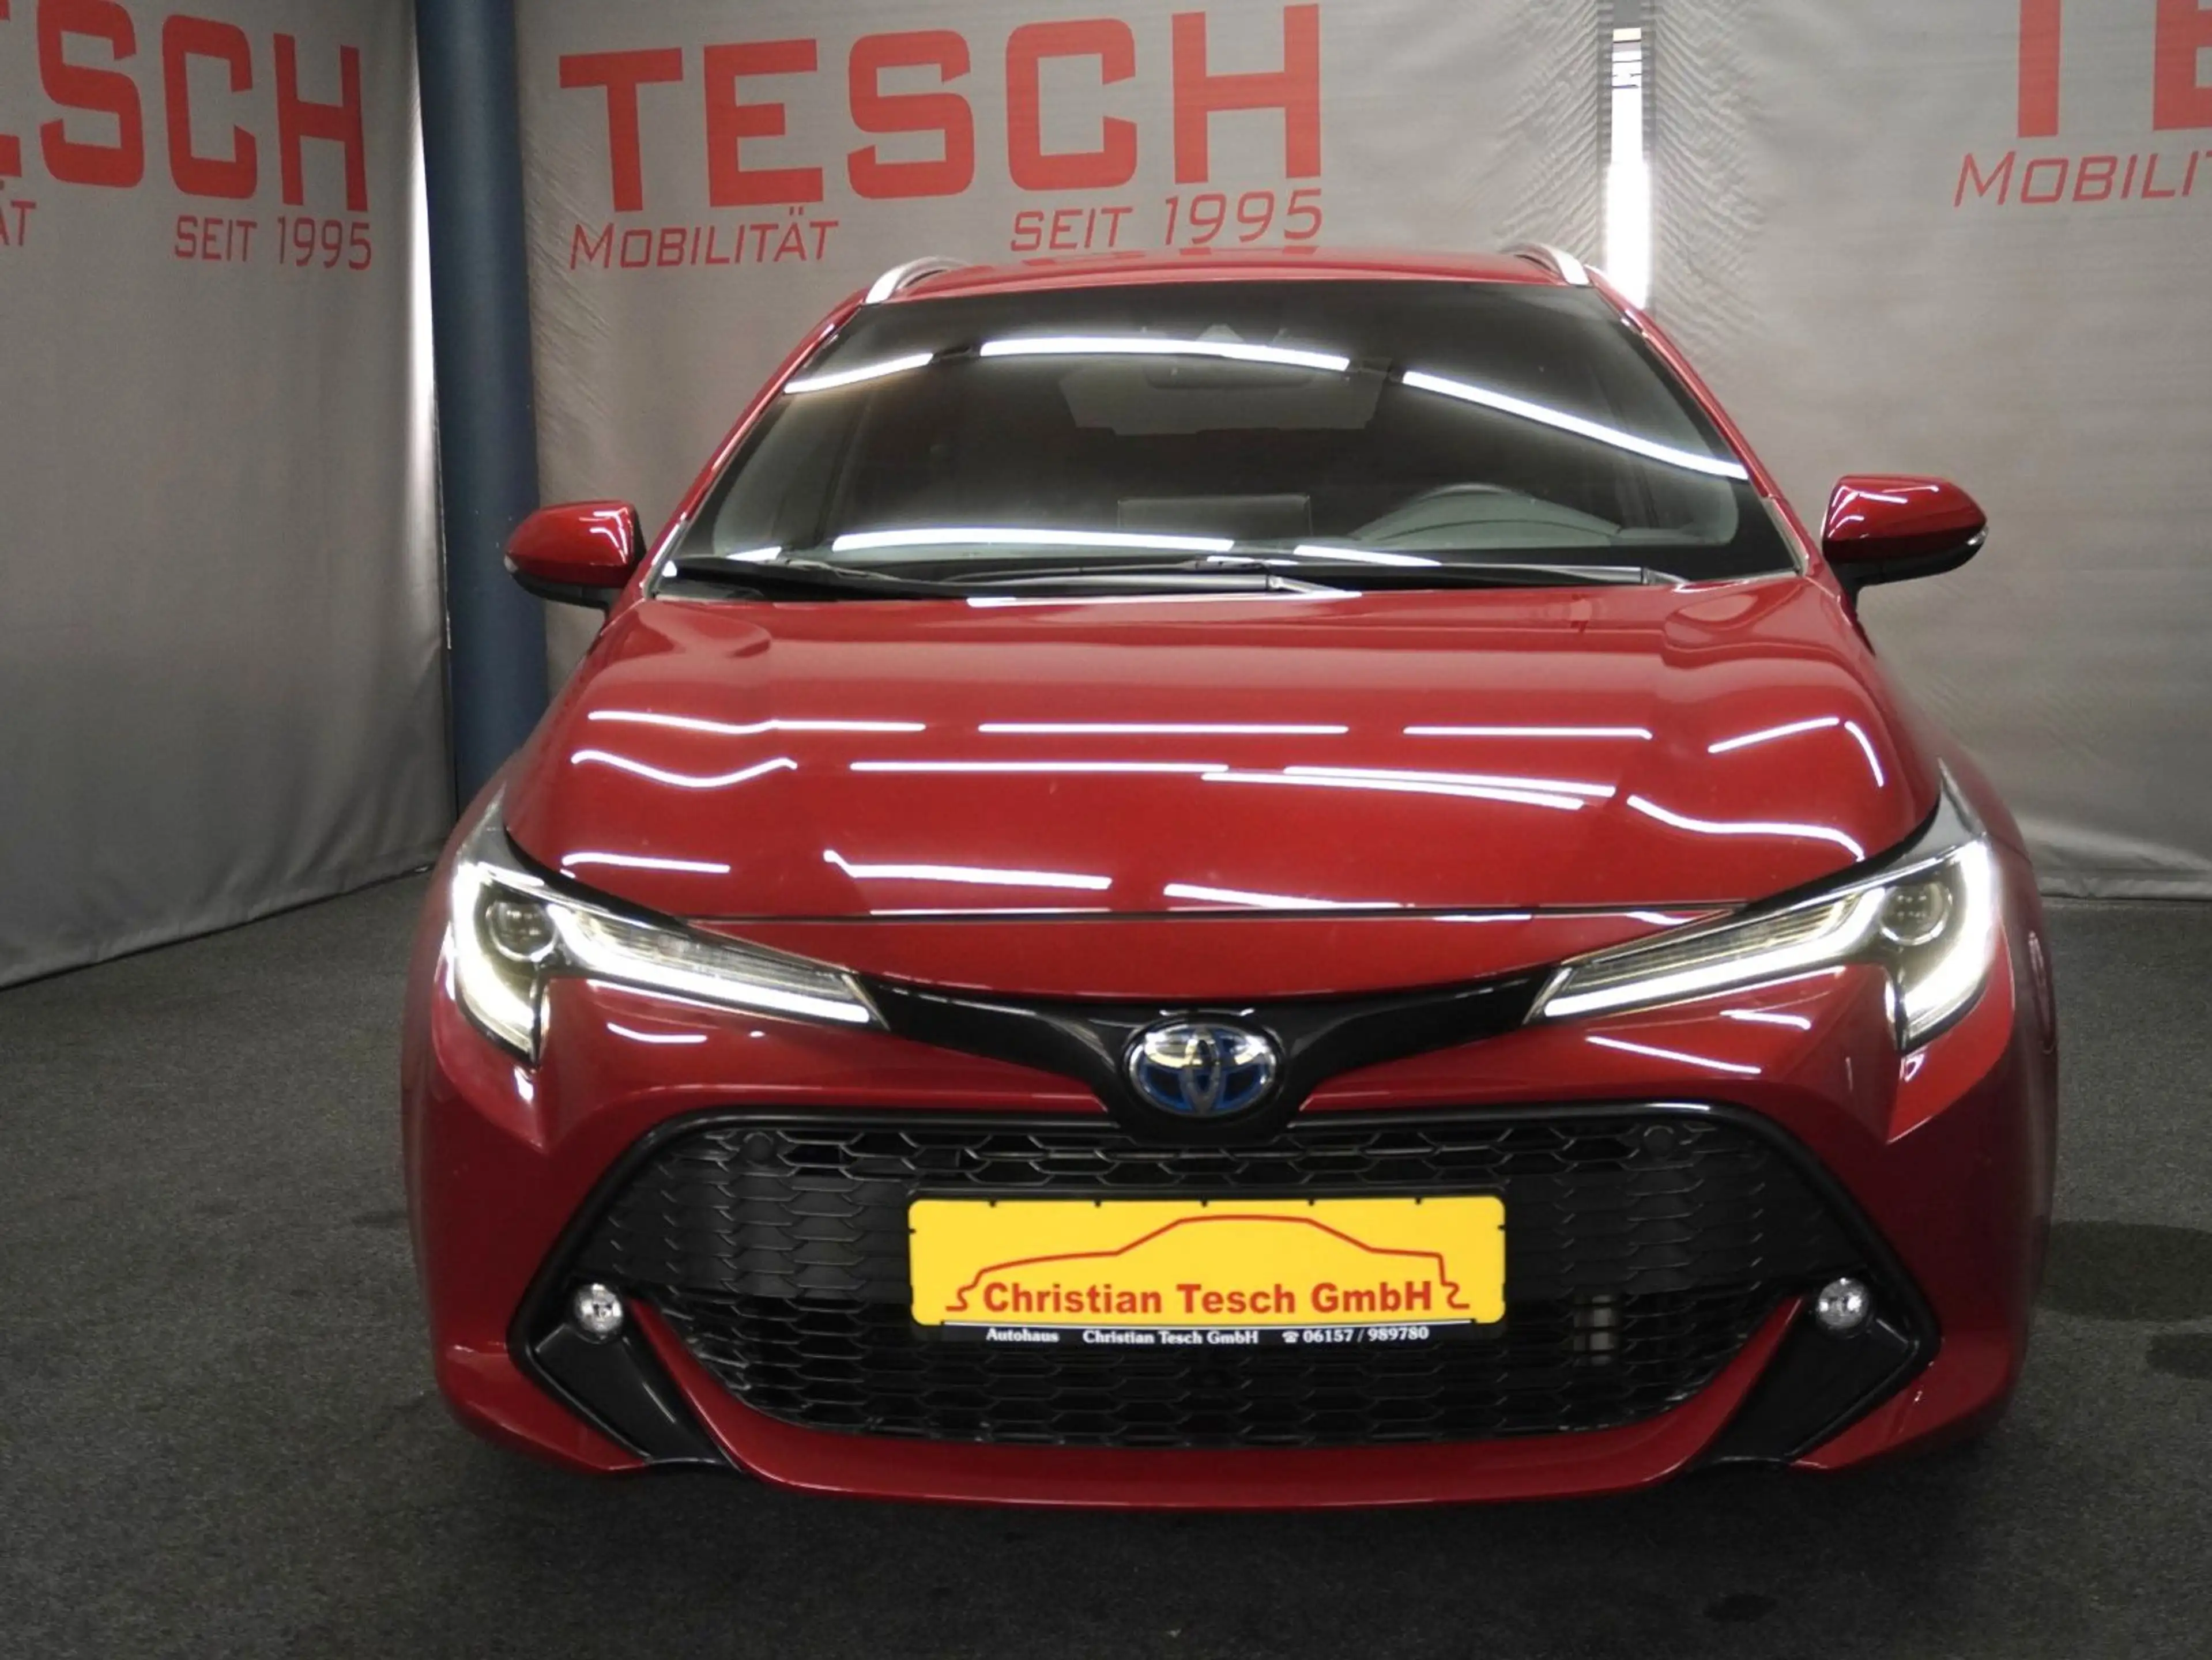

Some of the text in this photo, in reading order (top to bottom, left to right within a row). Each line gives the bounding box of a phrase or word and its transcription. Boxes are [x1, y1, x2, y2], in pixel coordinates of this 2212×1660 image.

[0, 0, 369, 212] SCH
[559, 3, 1322, 213] TESCH
[1953, 150, 2212, 208] MOBILI
[175, 214, 372, 271] SEIT 1995
[570, 207, 839, 270] MOBILITÄT
[1009, 187, 1324, 252] SEIT 1995
[982, 1280, 1432, 1315] Christian Tesch GmbH
[985, 1327, 1060, 1343] Autohaus
[1082, 1329, 1155, 1344] Christian
[1157, 1330, 1203, 1345] Tesch
[1206, 1330, 1259, 1345] GmbH
[1302, 1329, 1354, 1344] 06157
[1366, 1326, 1430, 1342] 989780
